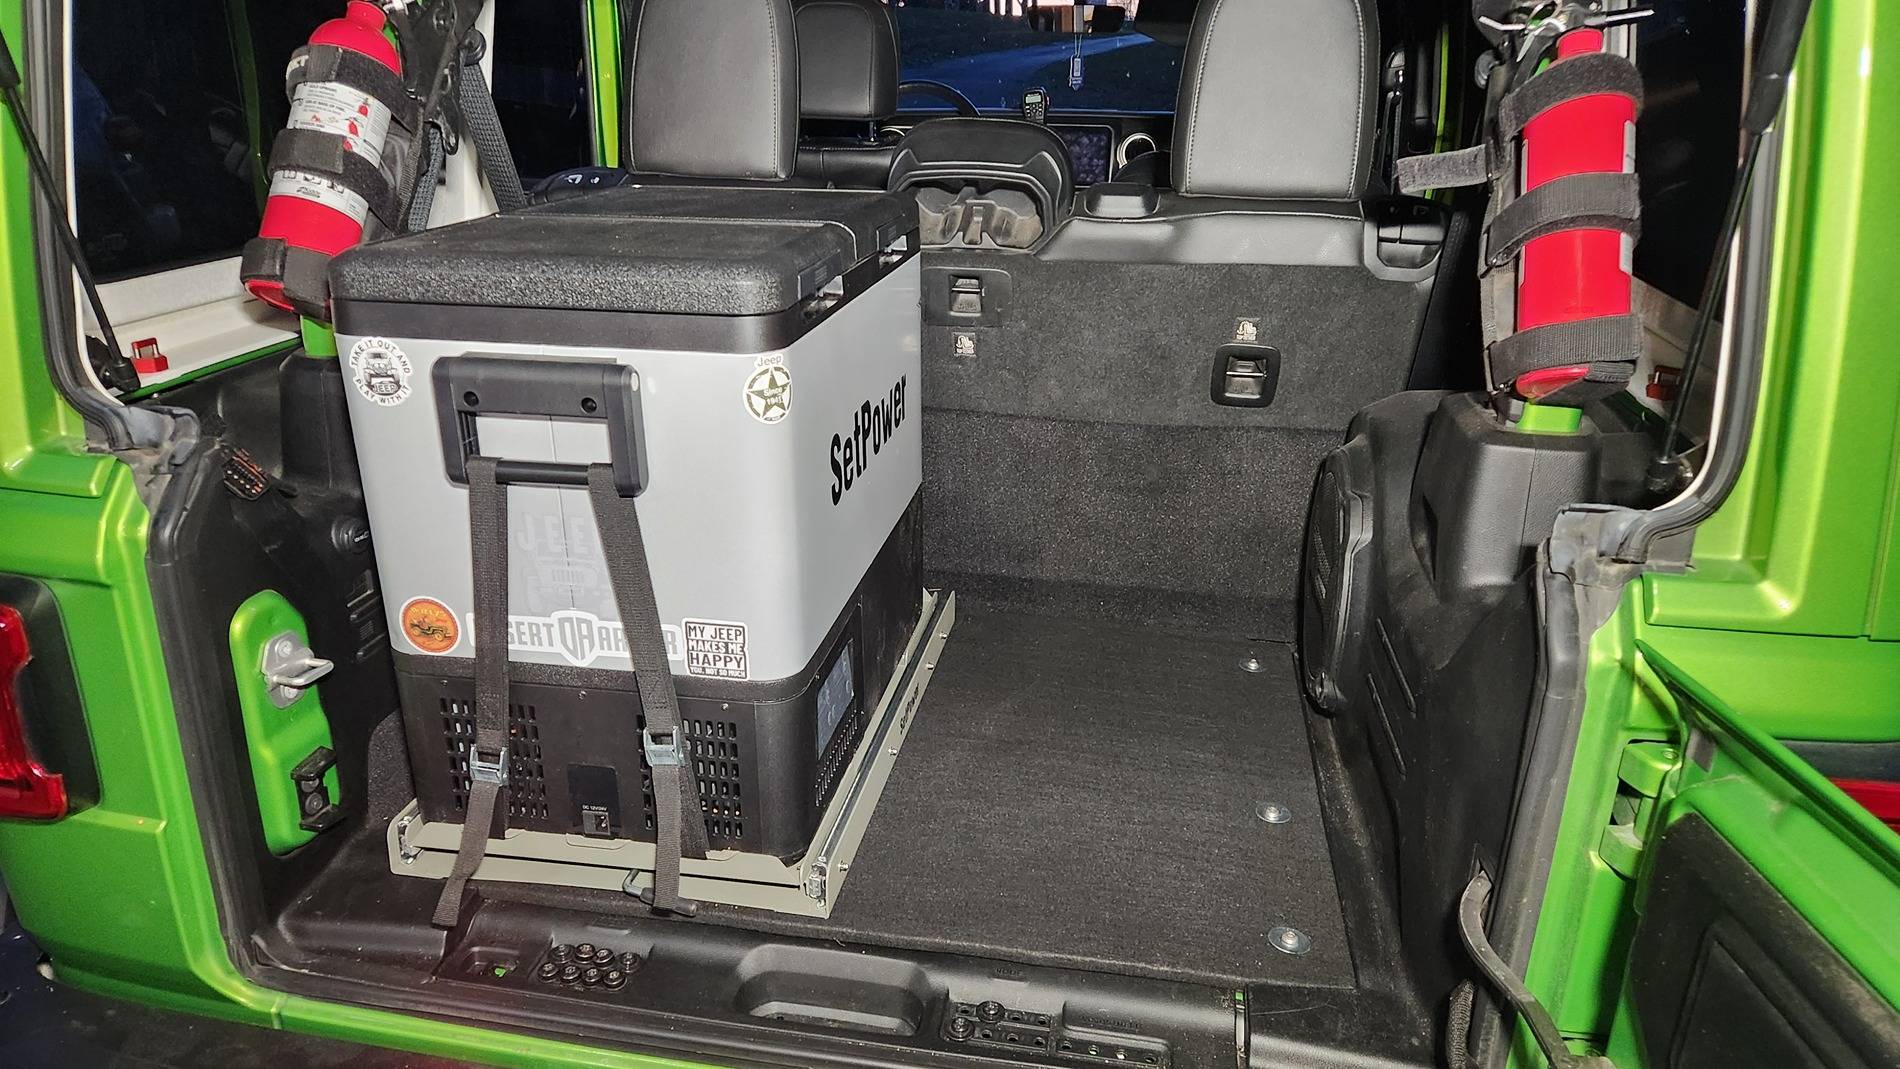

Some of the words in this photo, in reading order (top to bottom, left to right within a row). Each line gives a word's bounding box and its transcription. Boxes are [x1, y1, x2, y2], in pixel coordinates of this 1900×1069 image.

[351, 345, 365, 366] TAKE
[365, 340, 374, 348] IT
[377, 340, 396, 353] OUT
[397, 355, 411, 373] AND
[757, 355, 782, 367] Jeep
[355, 378, 376, 399] PLAY
[401, 384, 410, 396] IT
[373, 384, 396, 393] JEEP
[830, 373, 907, 507] SetPower
[515, 513, 590, 556] JEE
[508, 620, 554, 648] SERT
[597, 626, 679, 655] ARR
[687, 625, 705, 638] MY
[710, 627, 742, 642] JEEP
[688, 639, 726, 655] MAKES
[727, 642, 744, 655] ME
[689, 652, 743, 669] HAPPY
